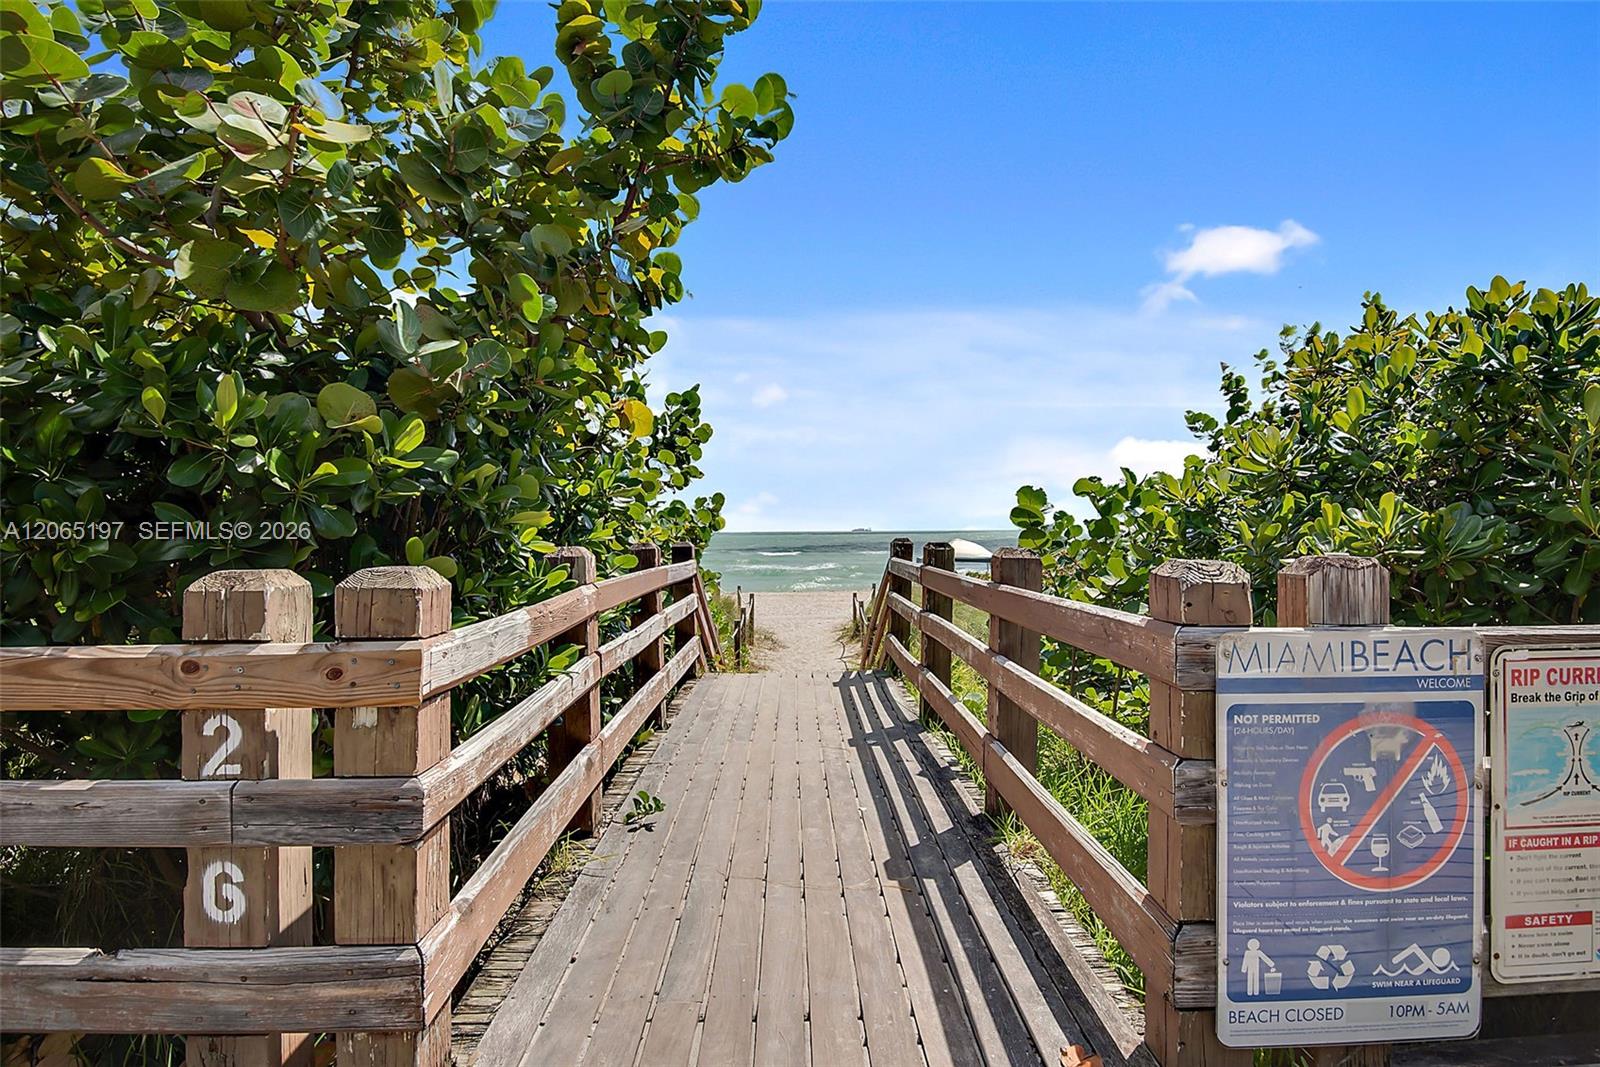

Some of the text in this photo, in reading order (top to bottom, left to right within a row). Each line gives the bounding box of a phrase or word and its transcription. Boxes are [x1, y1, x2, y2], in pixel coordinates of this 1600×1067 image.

[1416, 677, 1472, 689] WELCOME
[1511, 668, 1540, 687] RIP
[1511, 690, 1598, 704] Break the Grip of
[1234, 714, 1320, 724] NOT PERMITTED
[202, 713, 243, 777] 2
[1508, 836, 1598, 848] IF CAUGHT IN A RIP
[202, 860, 246, 924] 6
[1365, 898, 1394, 906] pursuant
[1524, 914, 1573, 926] SAFETY
[1423, 978, 1461, 987] LIFEGUARD
[1228, 1009, 1280, 1024] BEACH
[1285, 1007, 1344, 1023] CLOSED
[1389, 1004, 1425, 1018] 10PM
[1436, 1001, 1470, 1016] 5AM
